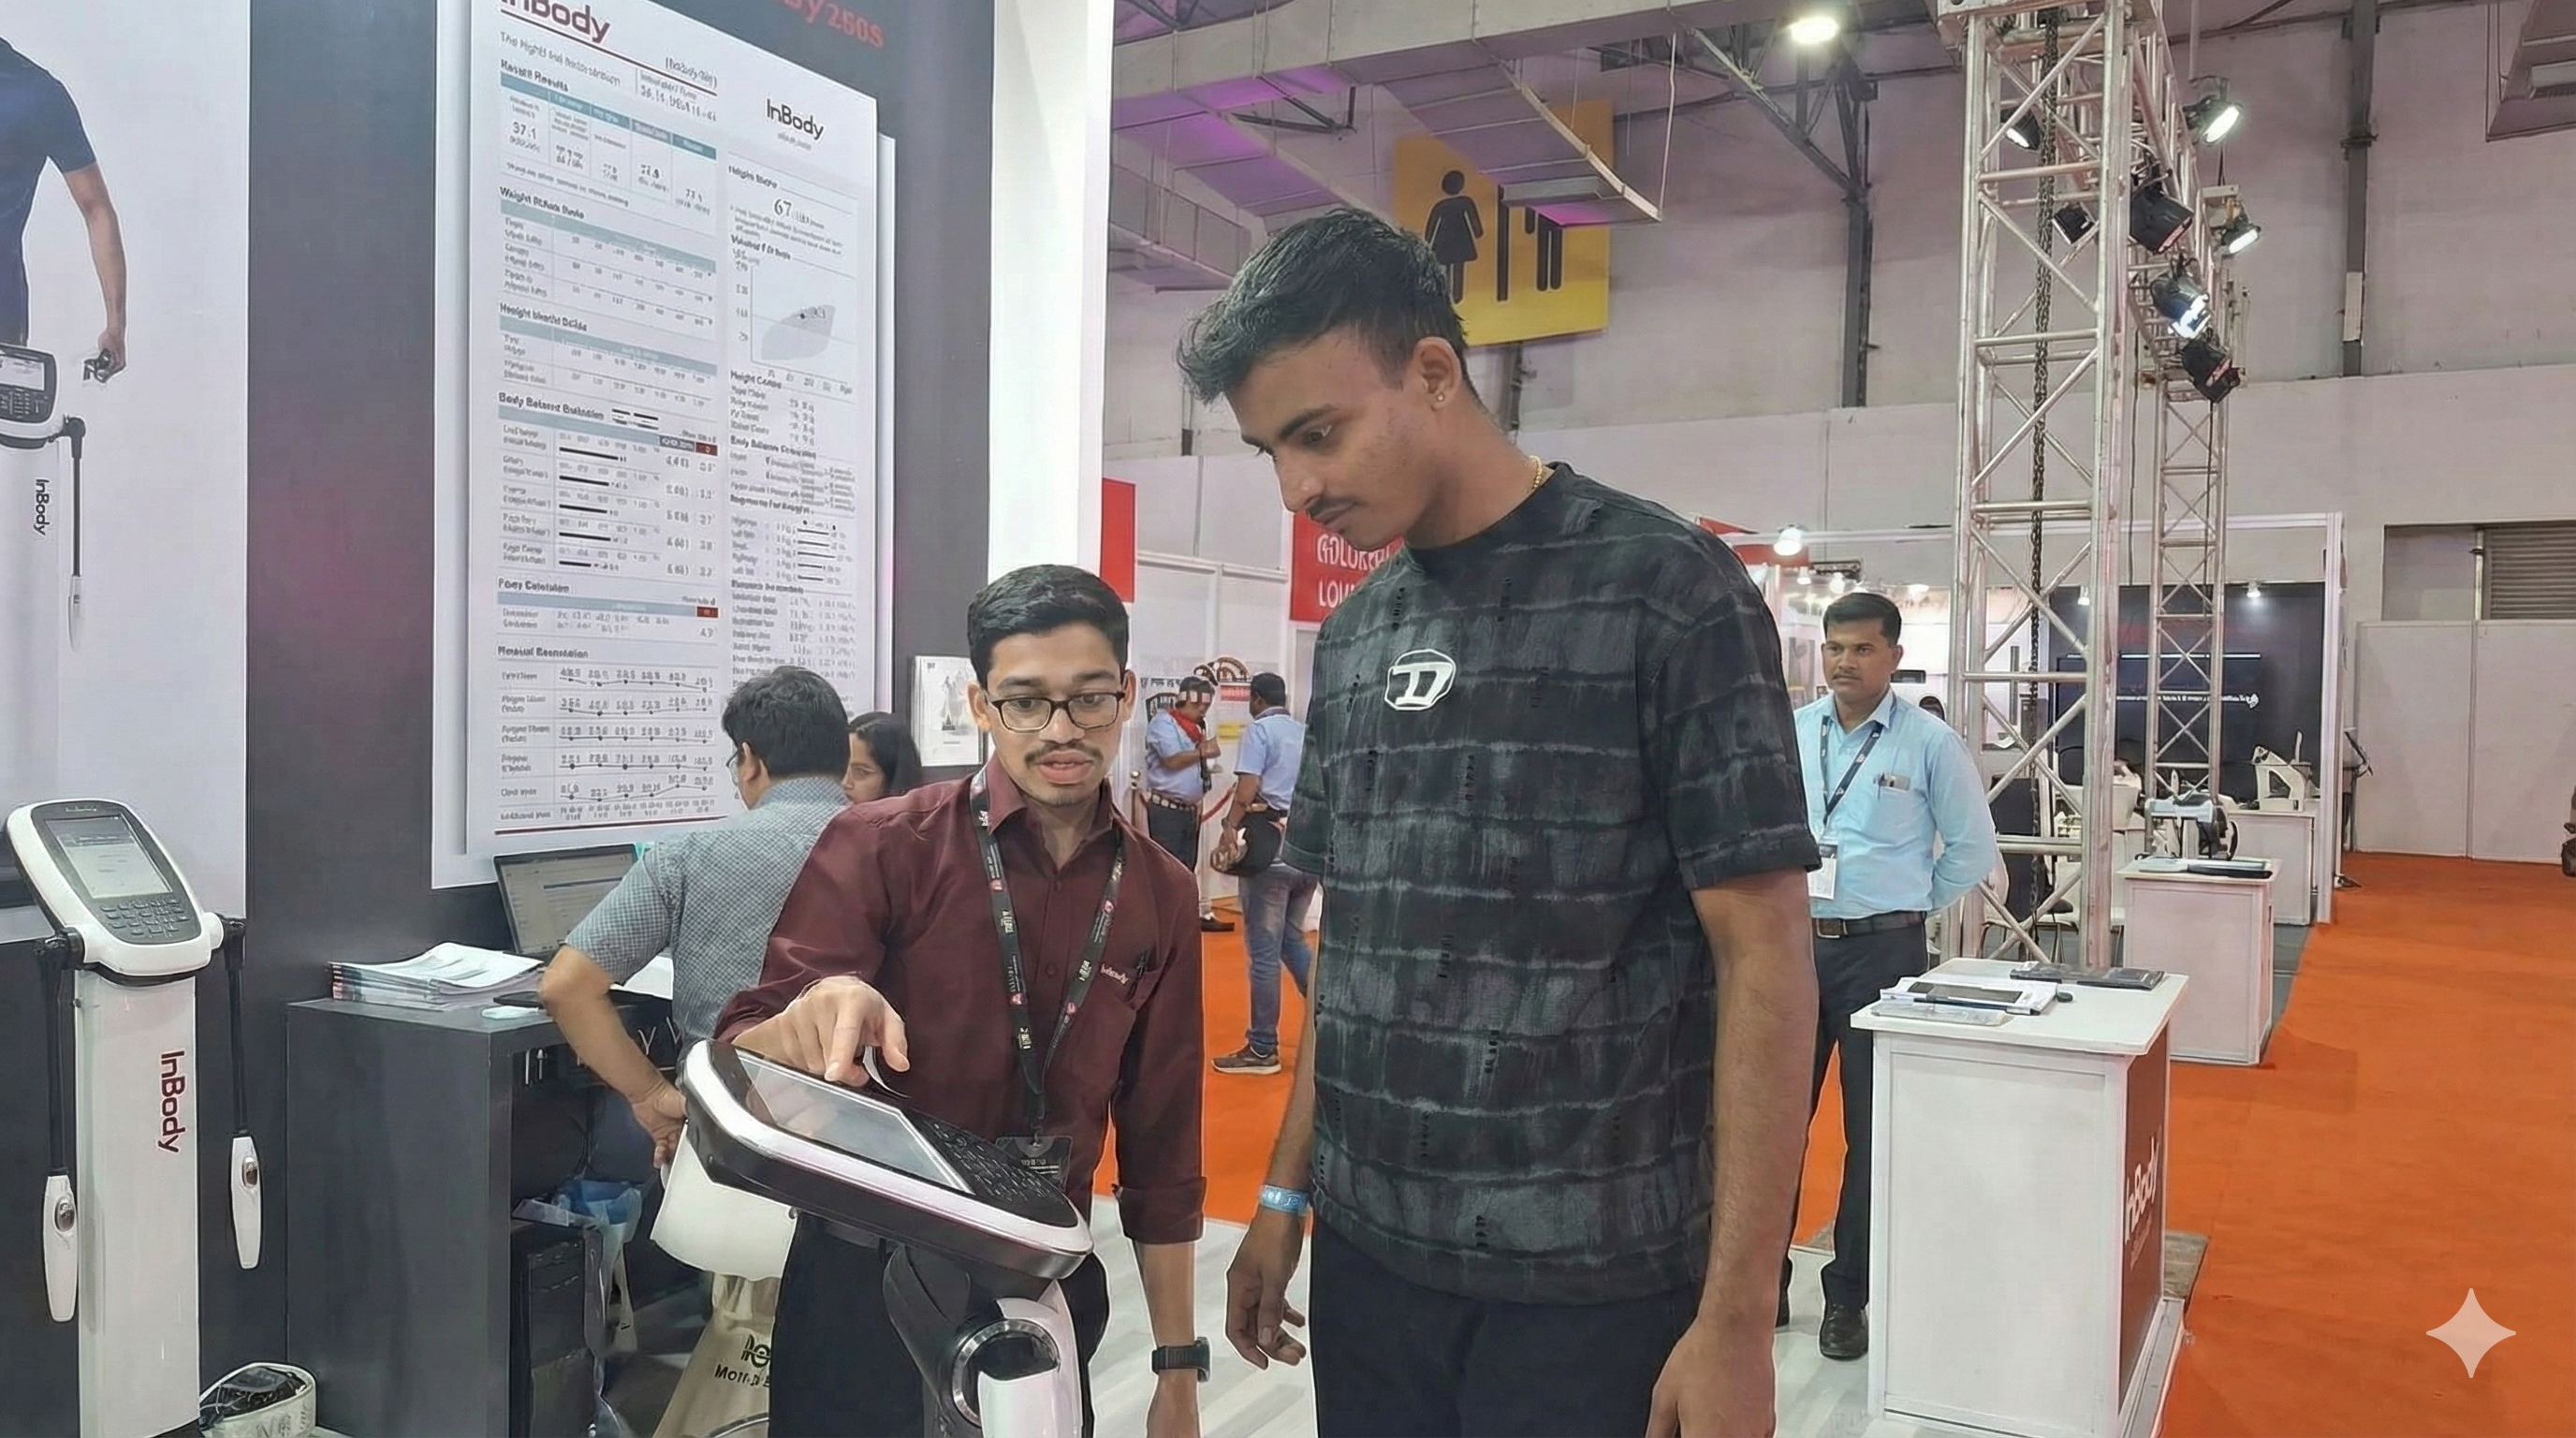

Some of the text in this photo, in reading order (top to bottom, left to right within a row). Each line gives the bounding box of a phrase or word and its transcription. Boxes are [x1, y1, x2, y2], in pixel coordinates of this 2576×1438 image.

[501, 0, 610, 43] Body
[766, 97, 825, 141] InBody
[34, 477, 51, 536] InBody
[157, 1050, 186, 1153] InBody
